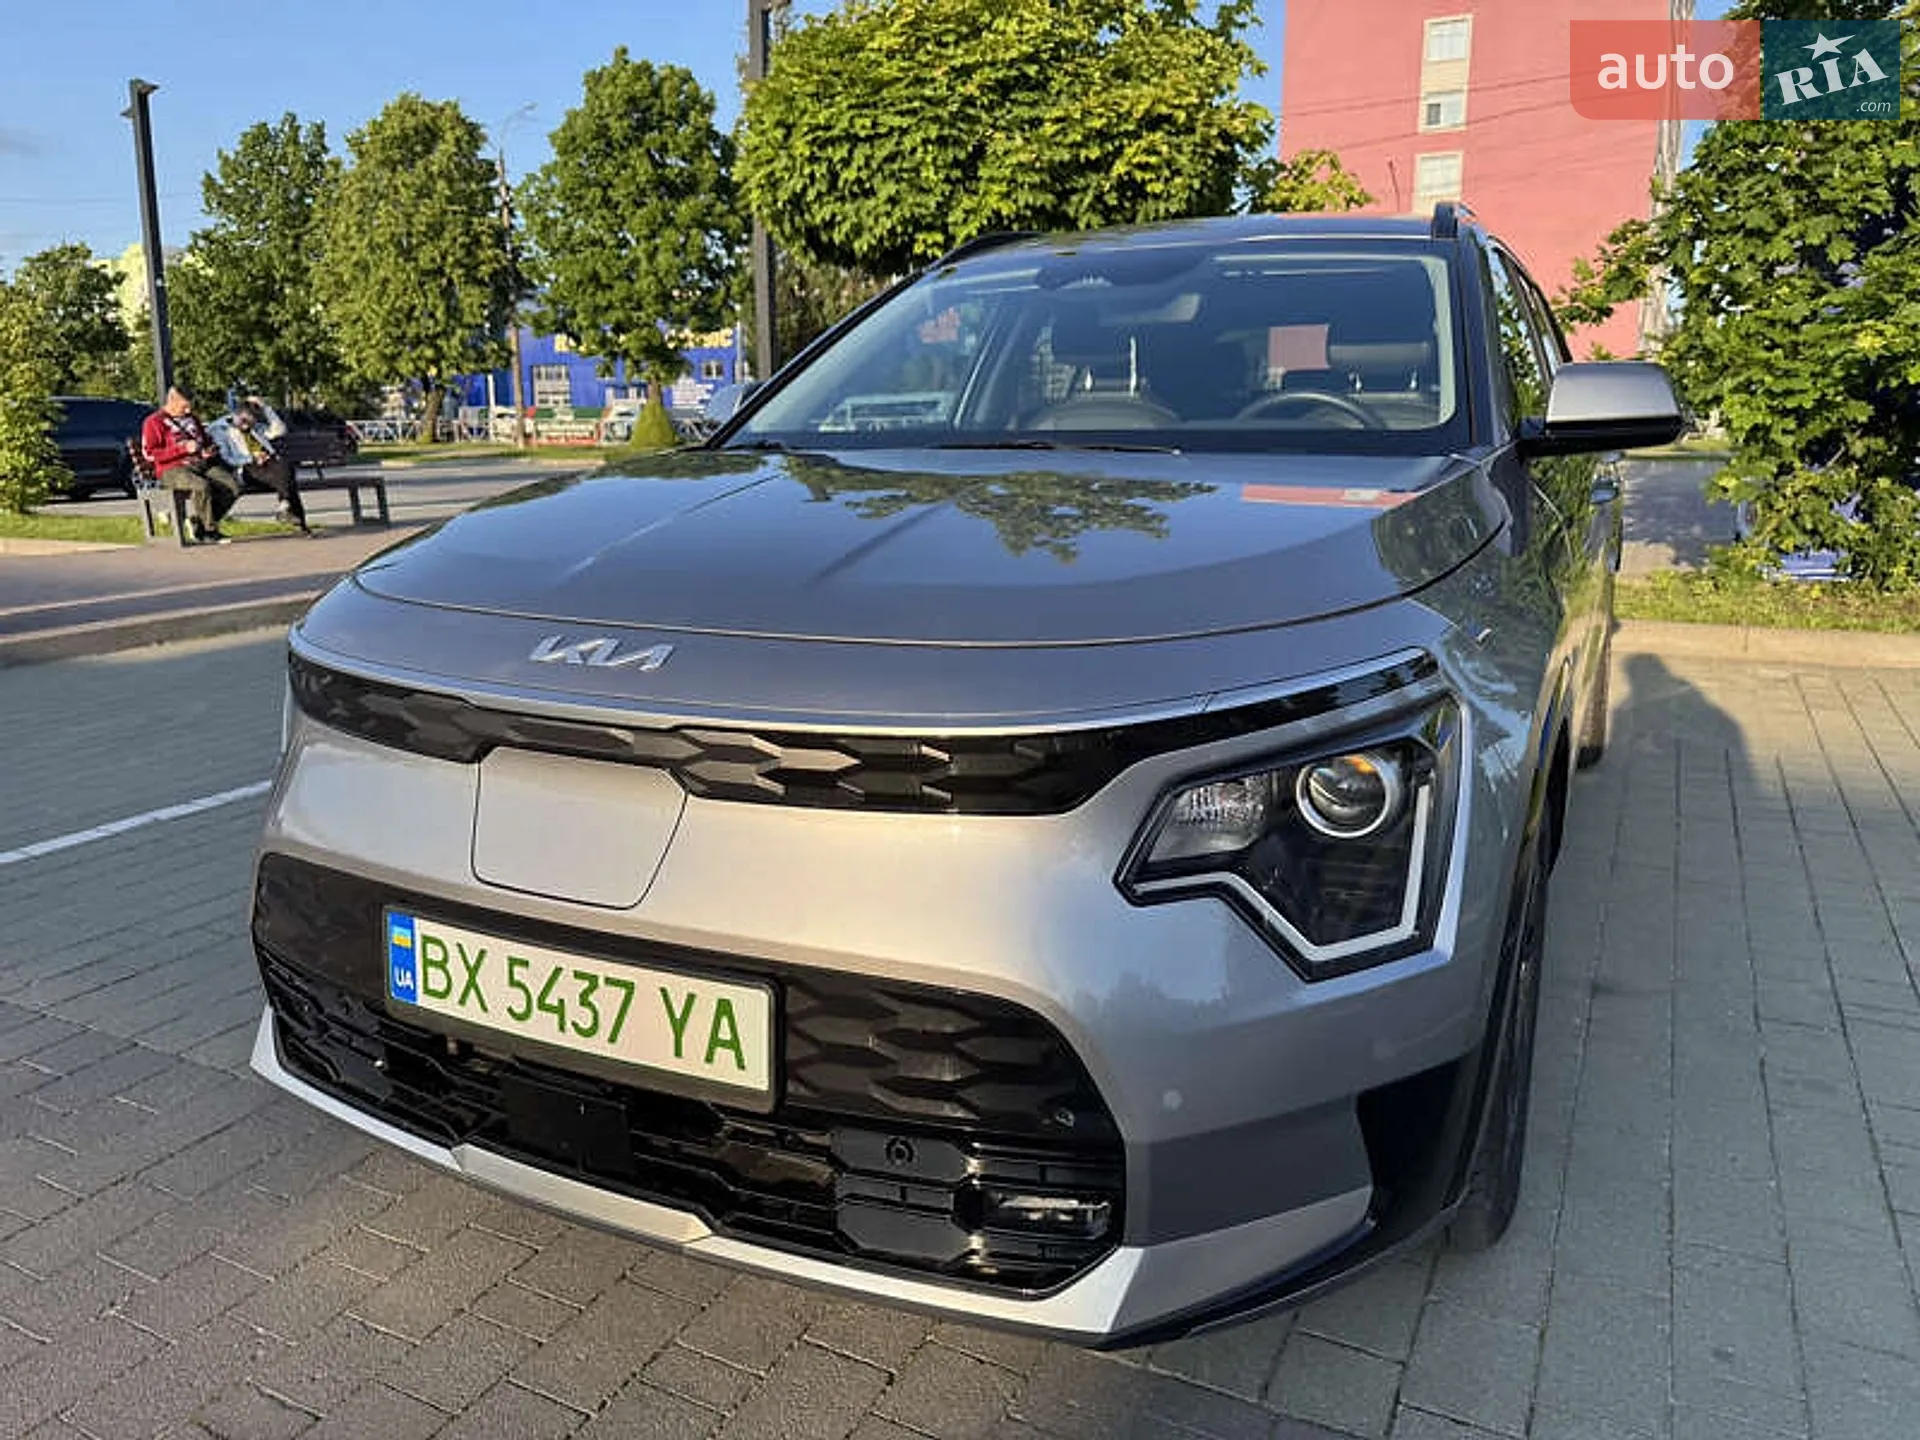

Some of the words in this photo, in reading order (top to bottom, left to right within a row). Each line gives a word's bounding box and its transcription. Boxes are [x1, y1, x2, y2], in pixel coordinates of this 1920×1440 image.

[529, 634, 676, 672] KIA
[393, 965, 415, 991] UA
[420, 934, 488, 1013] BX
[506, 956, 637, 1044] 5437
[659, 986, 745, 1071] YA
